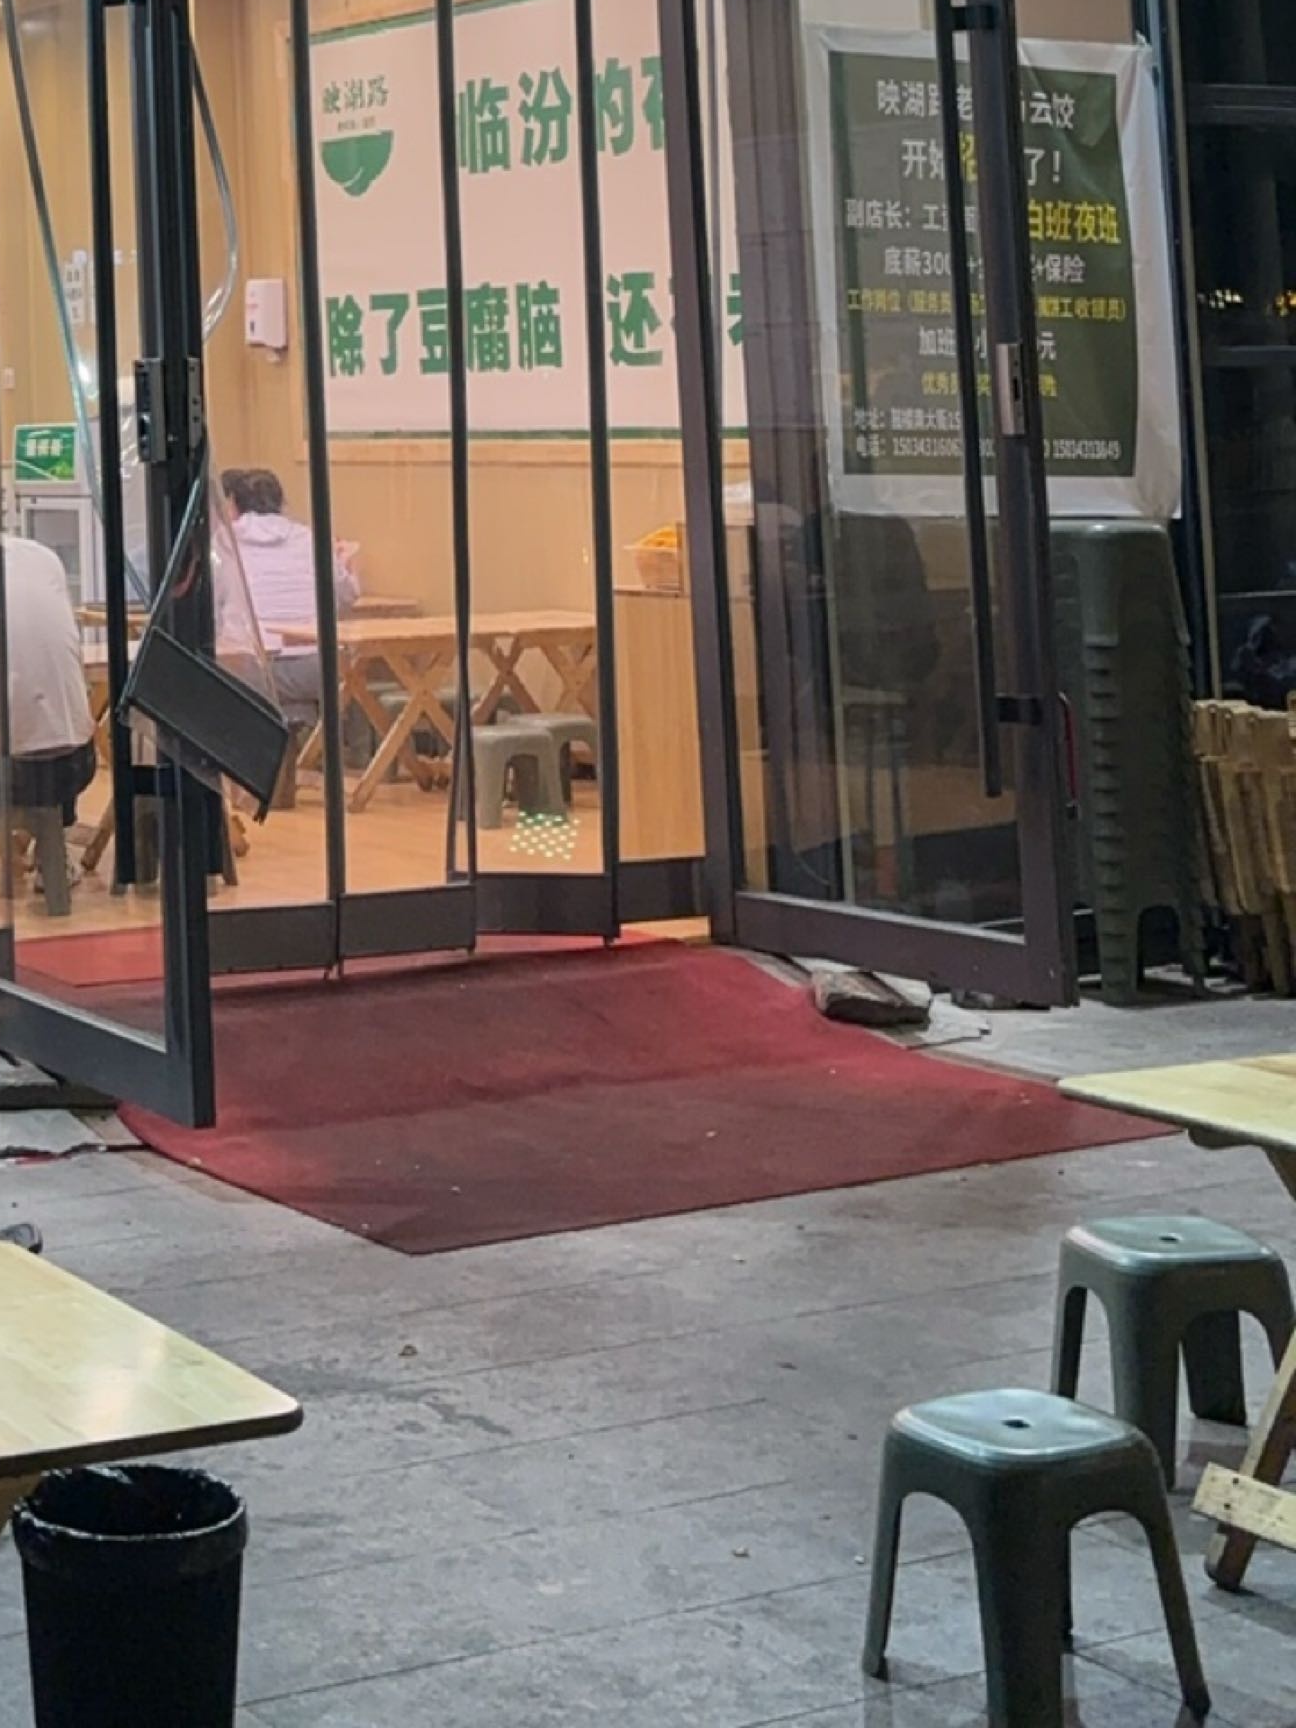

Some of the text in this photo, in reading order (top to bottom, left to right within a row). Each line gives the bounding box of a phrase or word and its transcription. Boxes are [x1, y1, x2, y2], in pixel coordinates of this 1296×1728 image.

[325, 280, 563, 378] 除了豆腐脑
